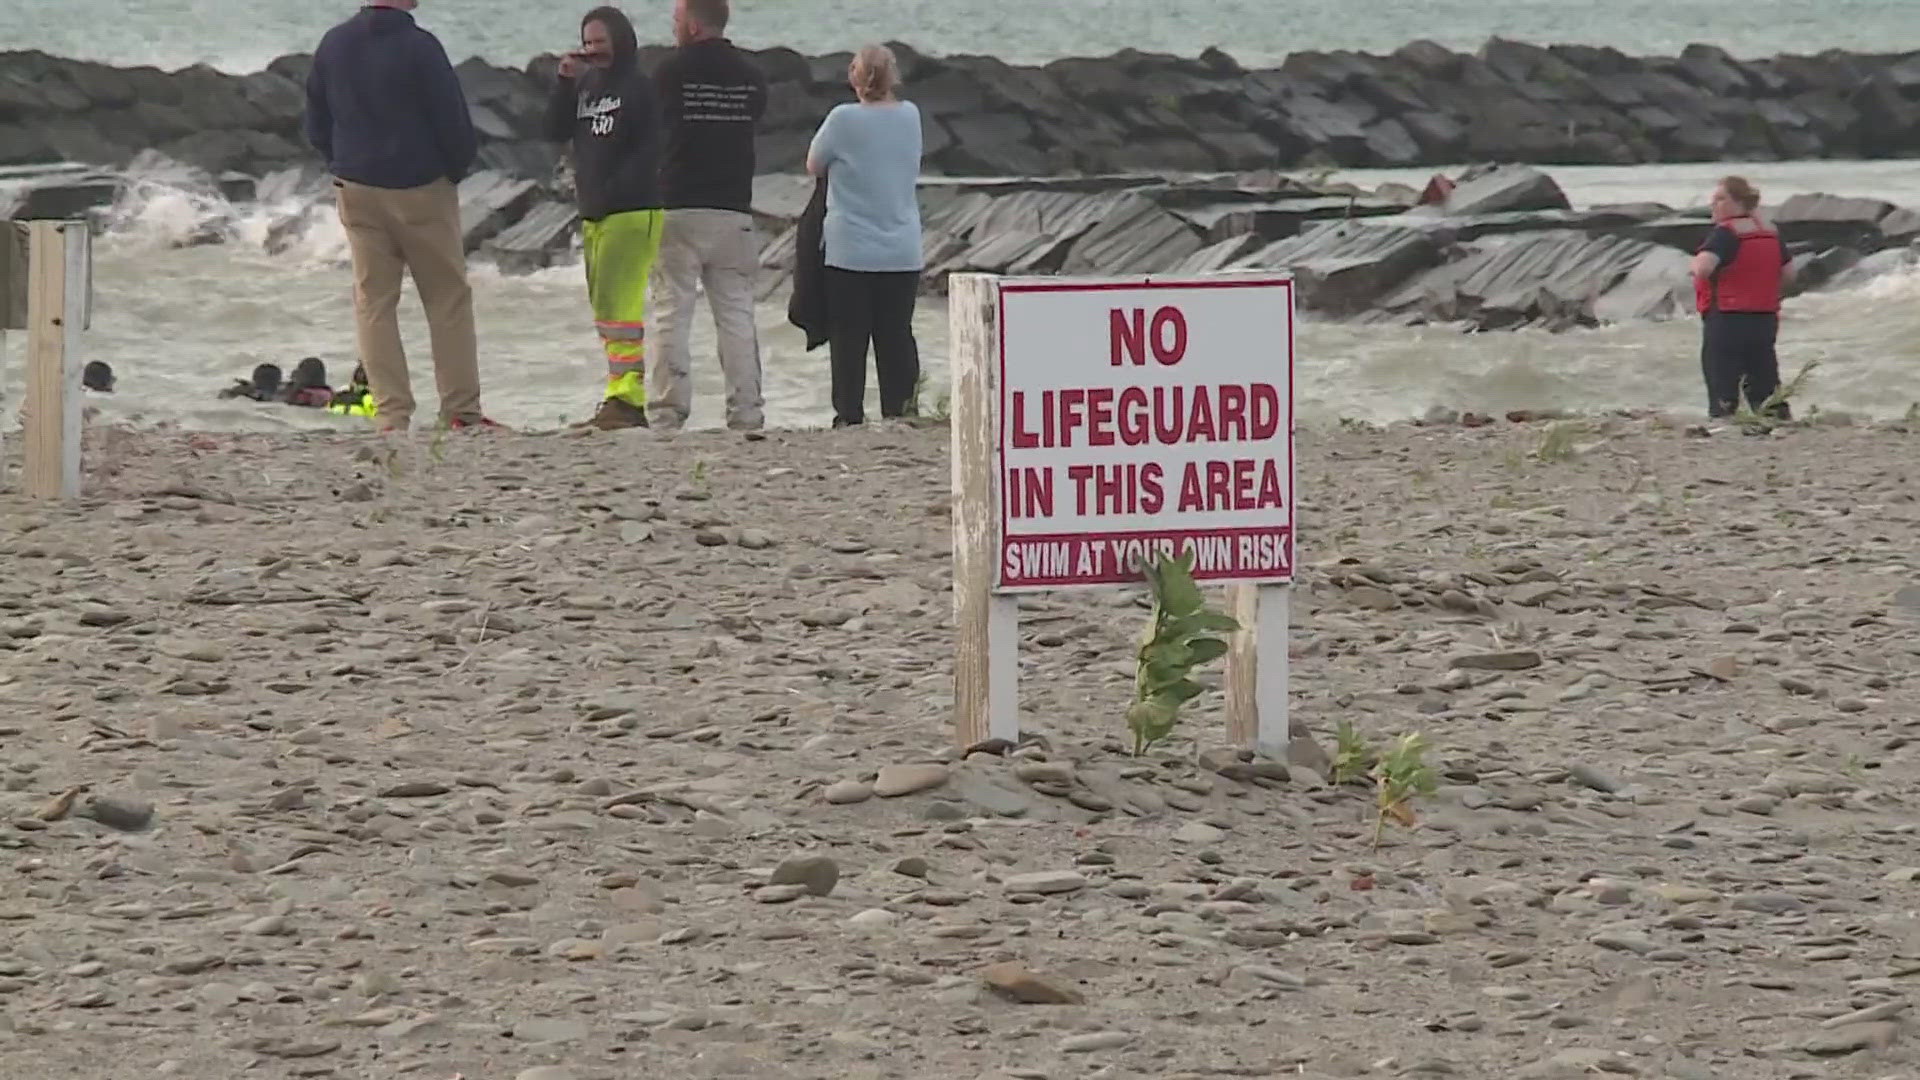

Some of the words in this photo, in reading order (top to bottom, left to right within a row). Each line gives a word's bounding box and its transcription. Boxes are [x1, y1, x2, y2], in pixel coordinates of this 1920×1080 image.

[1110, 306, 1187, 366] NO
[1012, 383, 1279, 448] LIFEGUARD
[1010, 467, 1053, 518] IN
[1068, 462, 1164, 515] THIS
[1178, 459, 1283, 512] AREA
[1005, 542, 1070, 579] SWIM
[1076, 541, 1106, 576] AT
[1181, 536, 1232, 572] OWN
[1238, 534, 1289, 570] RISK
